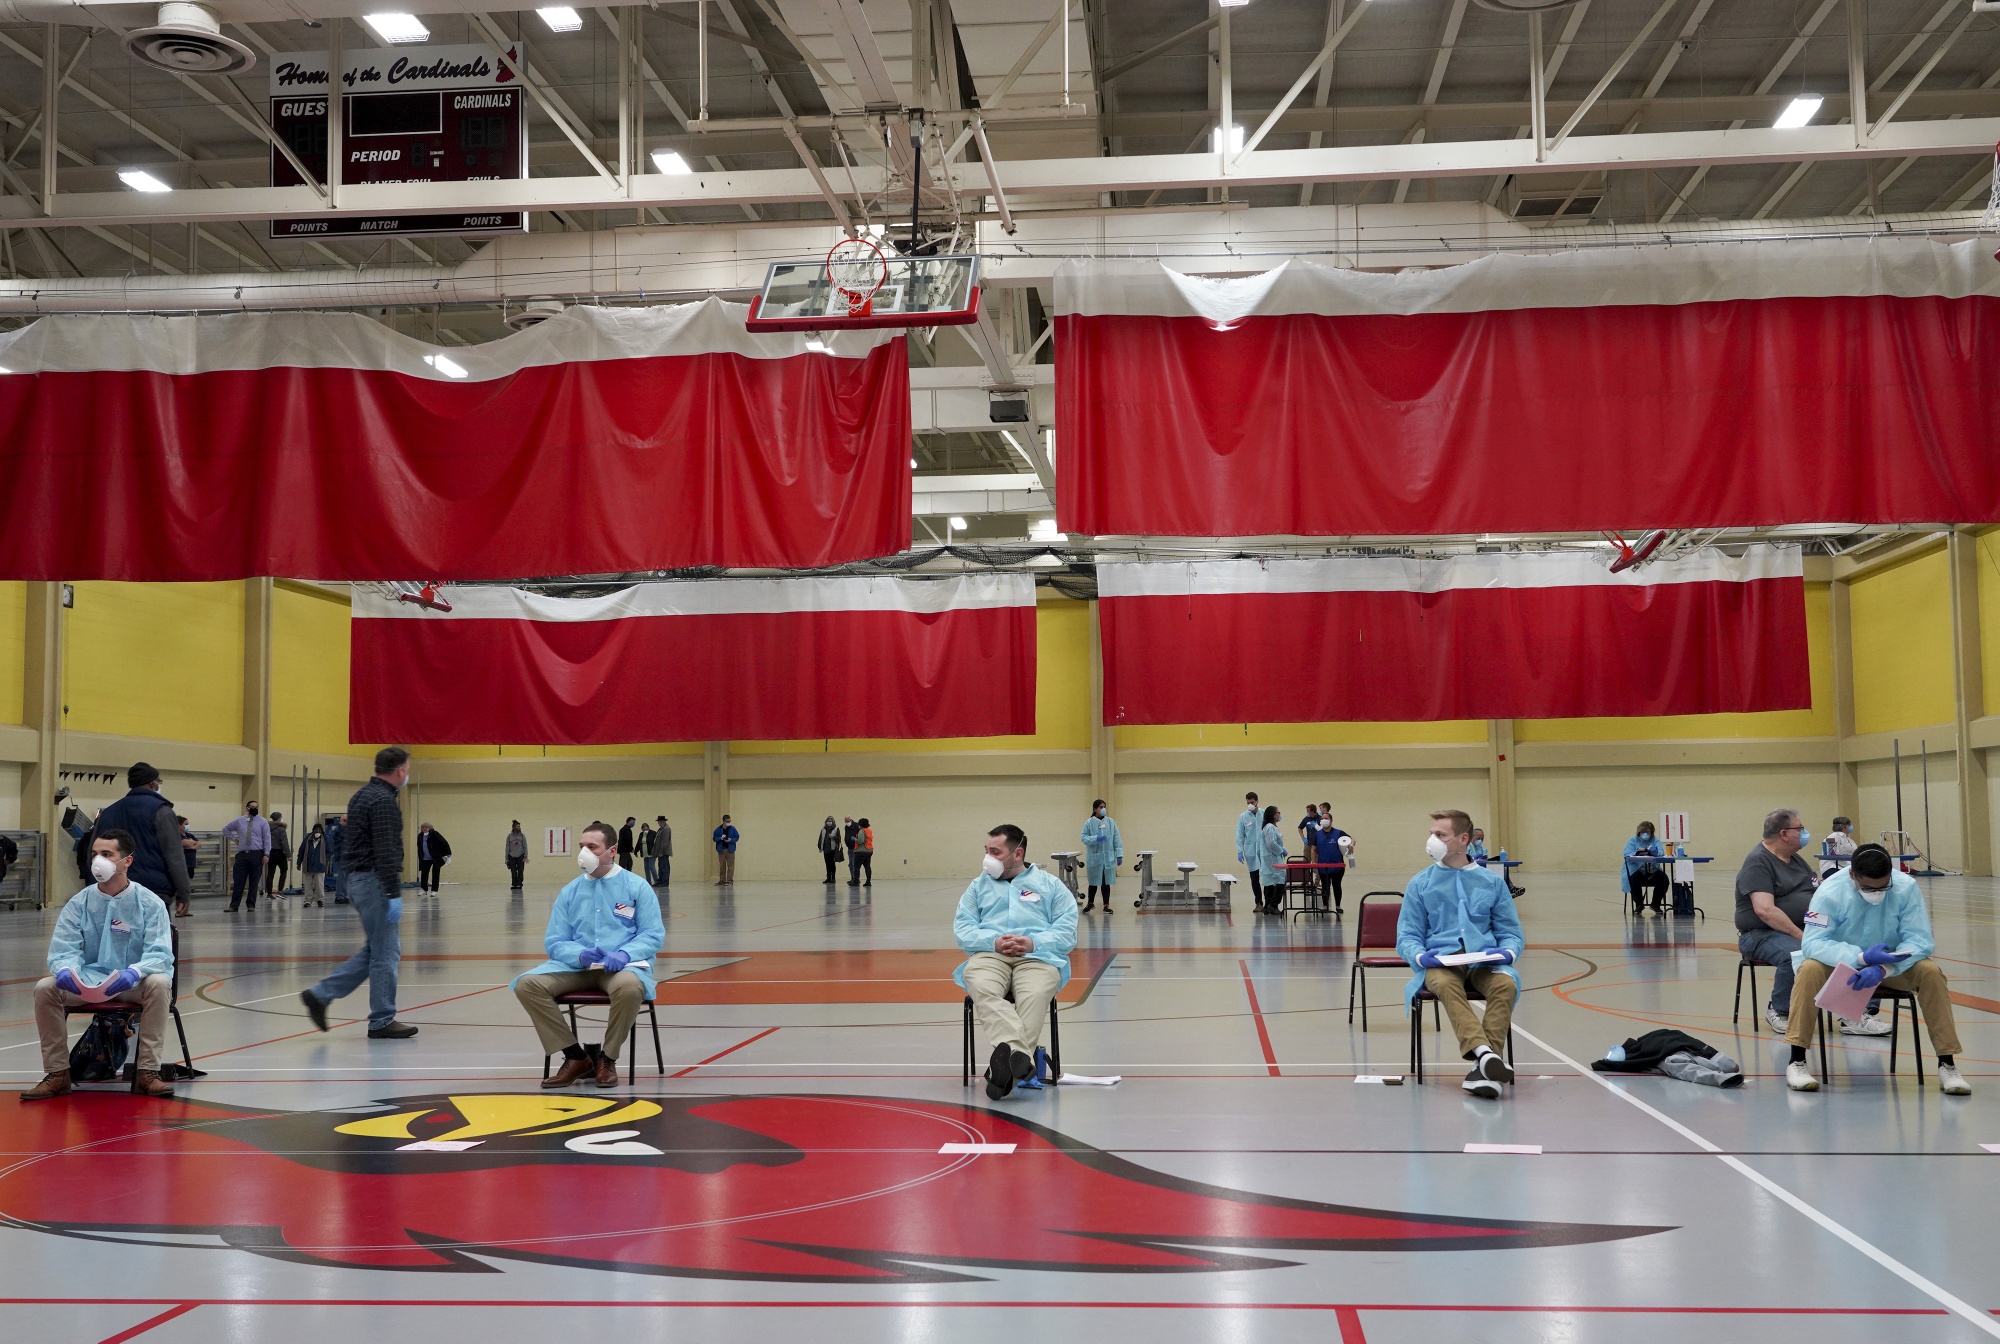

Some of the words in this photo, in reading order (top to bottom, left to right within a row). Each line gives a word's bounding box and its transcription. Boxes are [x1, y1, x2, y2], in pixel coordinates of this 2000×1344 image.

[342, 68, 357, 87] of
[360, 66, 381, 82] the
[387, 56, 490, 84] Cardinals
[454, 93, 511, 109] CARDINALS
[281, 101, 328, 117] GUES
[350, 150, 400, 163] PERIOD
[290, 222, 328, 232] POINTS
[360, 220, 398, 230] MATCH
[463, 216, 502, 226] POINTS
